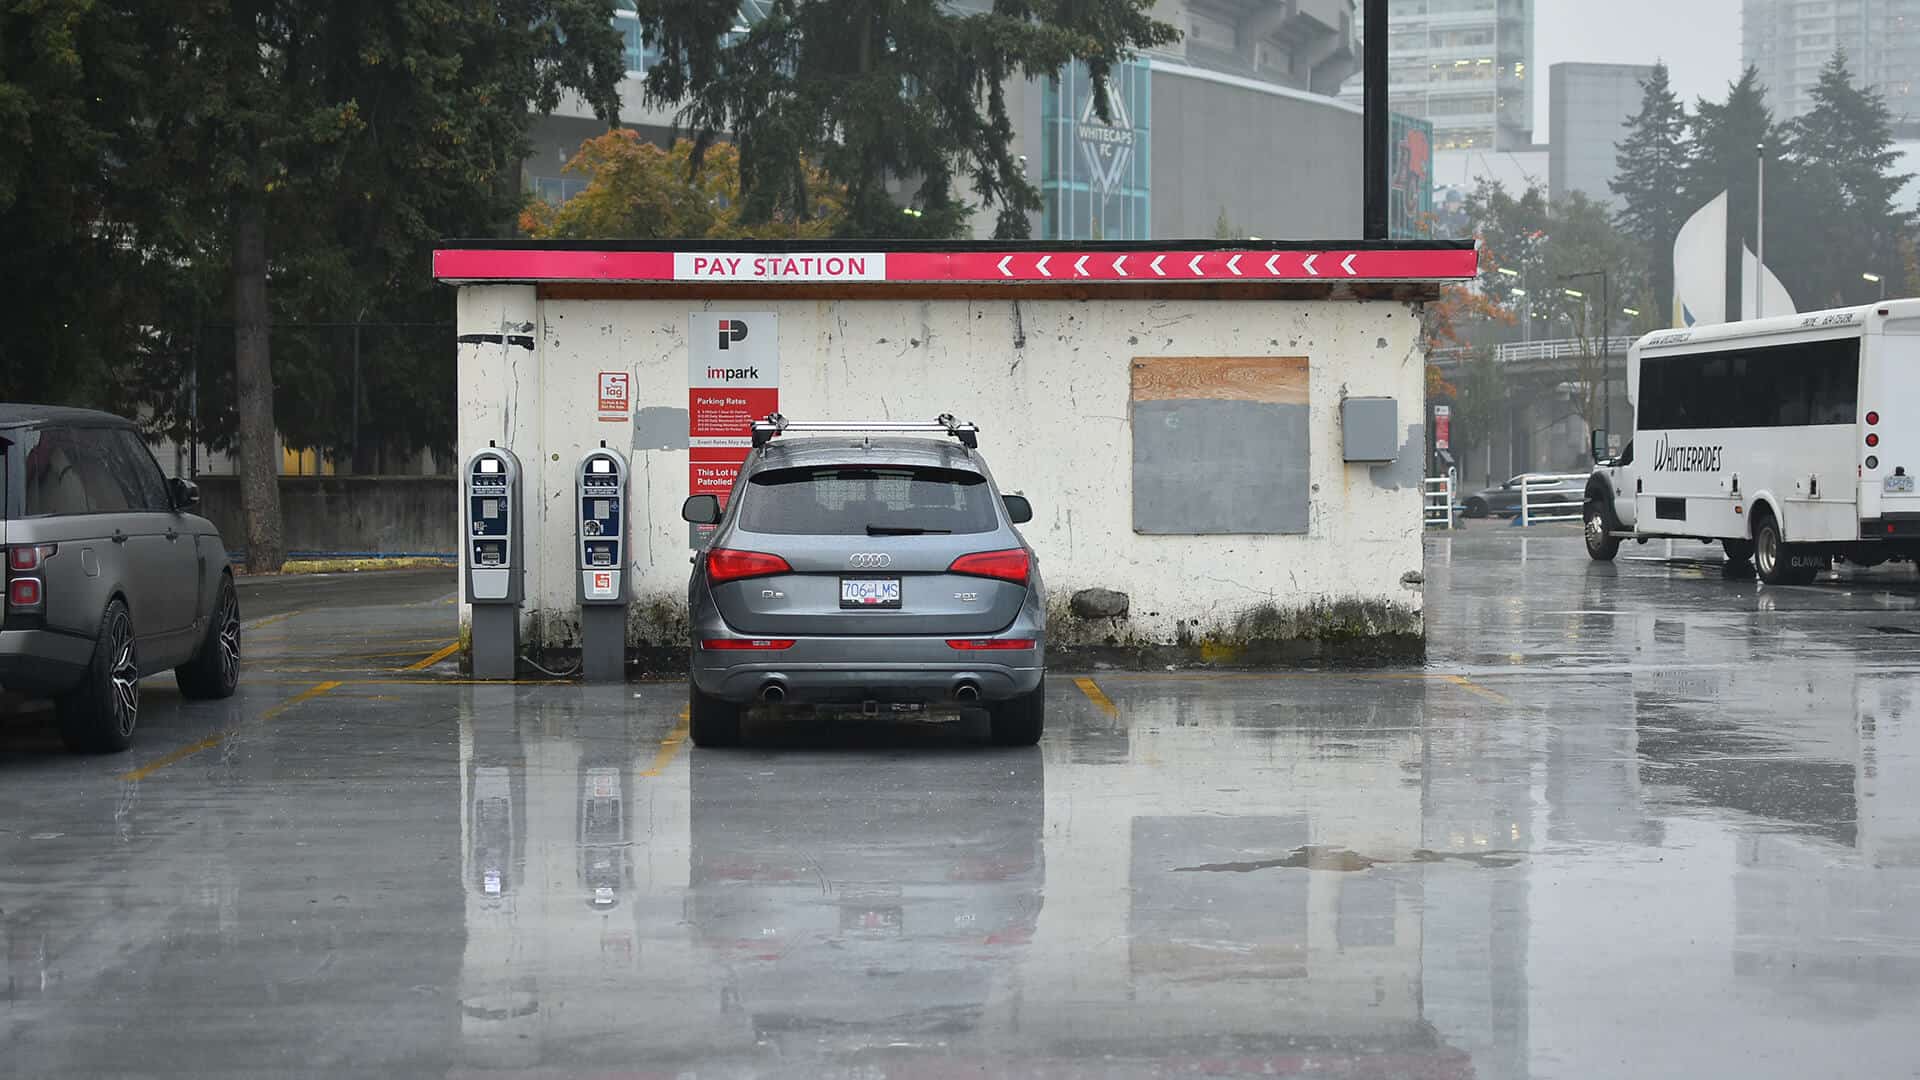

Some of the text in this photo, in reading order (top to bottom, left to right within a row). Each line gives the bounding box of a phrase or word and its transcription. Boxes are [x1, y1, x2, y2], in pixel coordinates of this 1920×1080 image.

[1079, 126, 1132, 145] WHITECAPS
[1100, 143, 1112, 157] FC
[694, 257, 865, 275] PAY STATION
[707, 365, 758, 382] impark
[606, 387, 623, 398] Tag
[697, 397, 746, 407] Parking Rates
[1654, 432, 1722, 472] WHISTLERRIDES
[697, 468, 714, 476] This
[716, 468, 729, 476] Lot
[697, 478, 732, 486] Patrolled
[843, 583, 898, 598] 706 LMS
